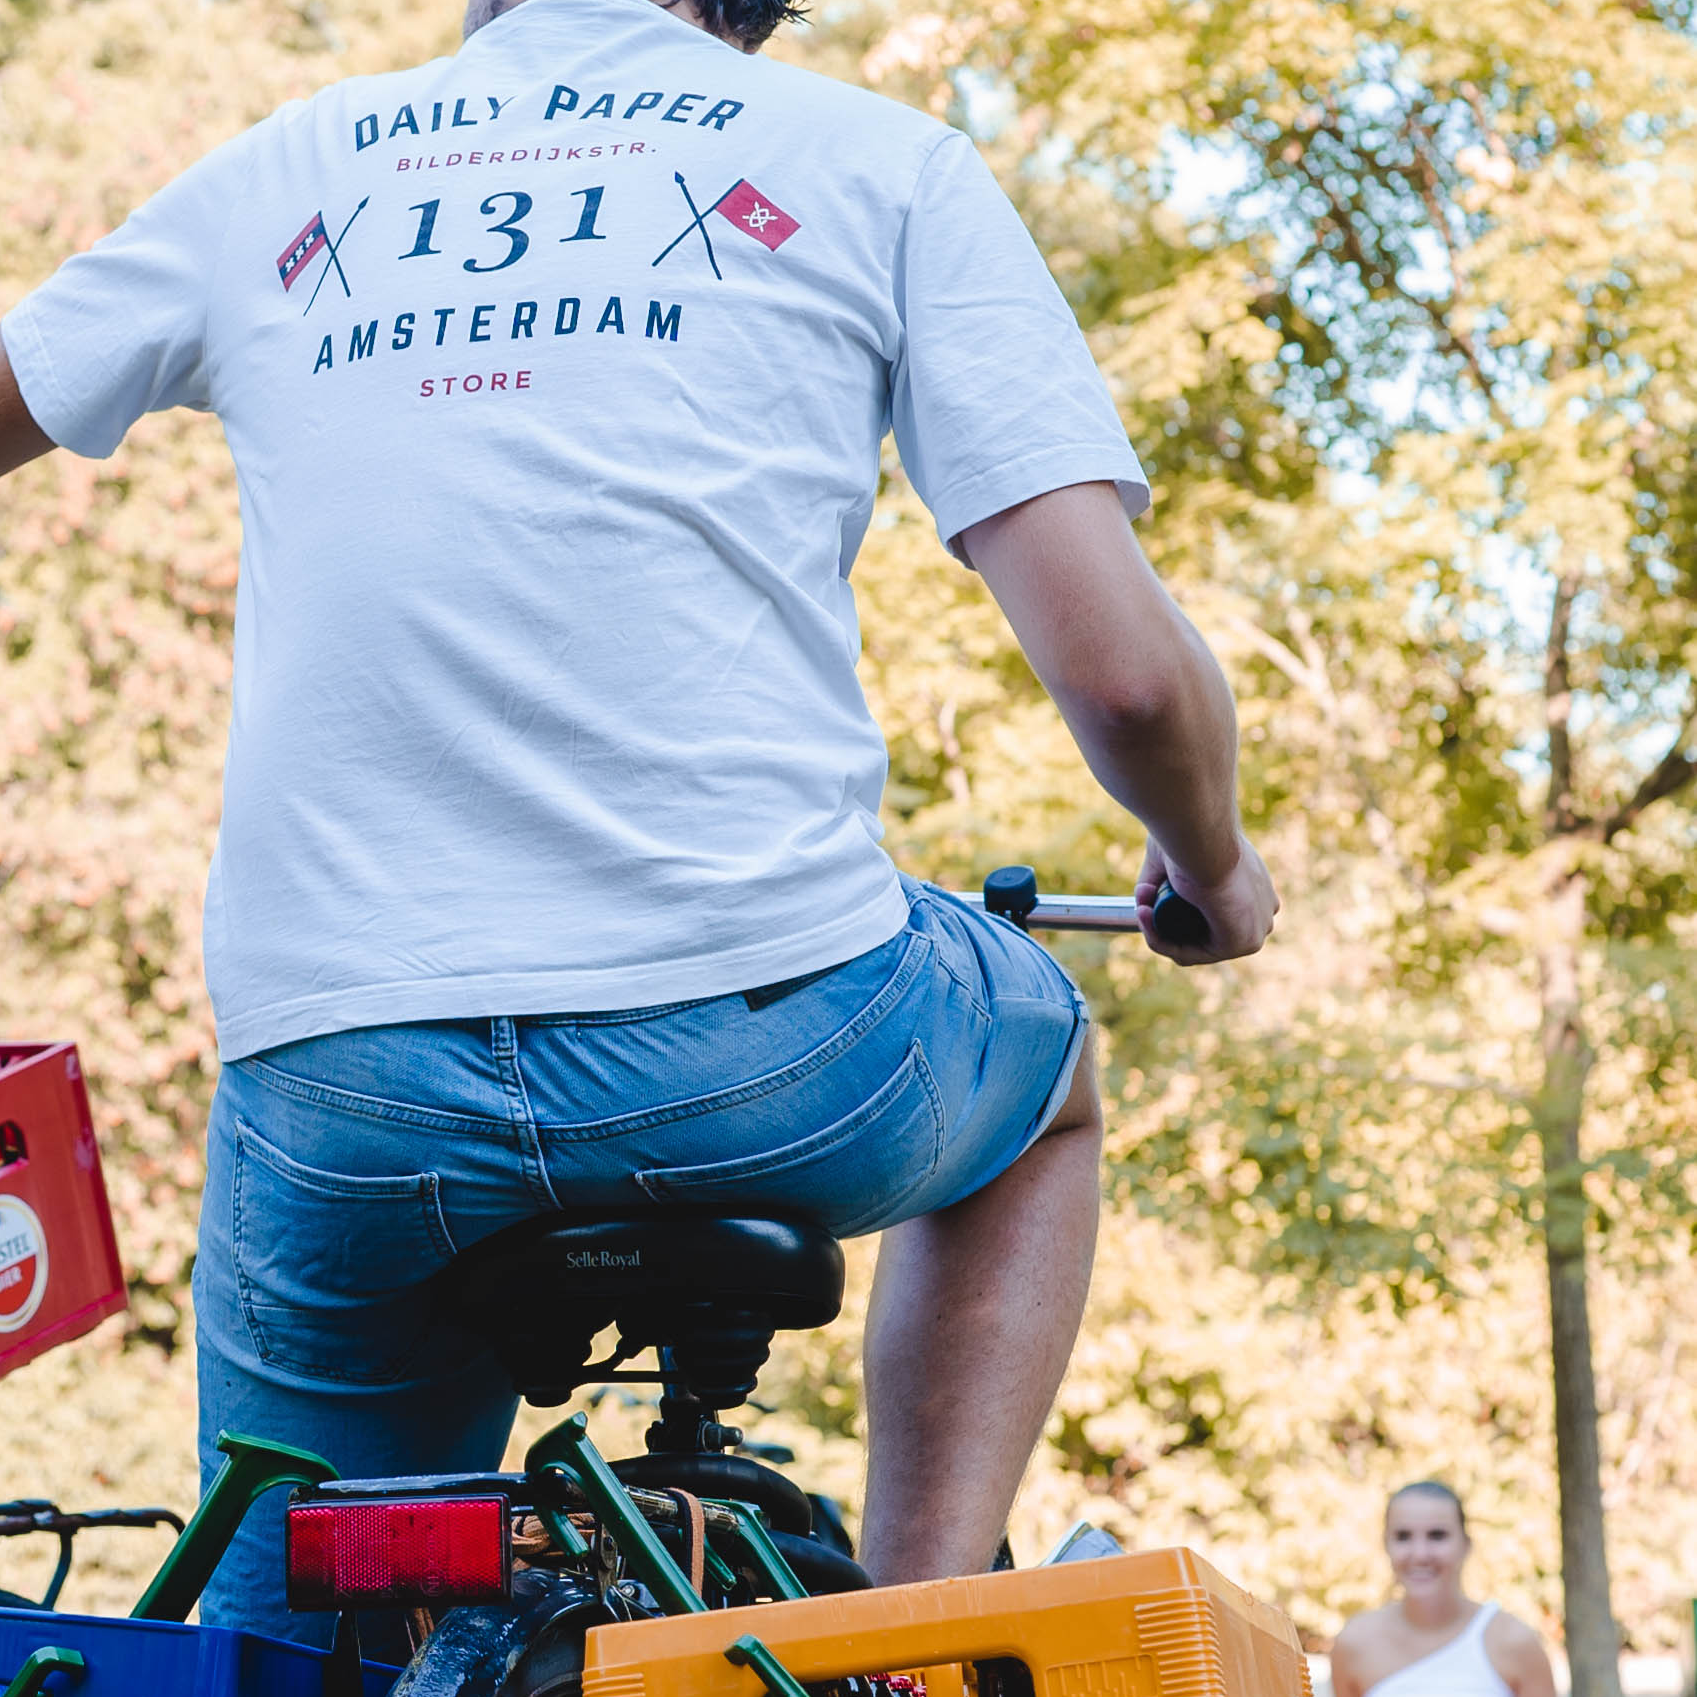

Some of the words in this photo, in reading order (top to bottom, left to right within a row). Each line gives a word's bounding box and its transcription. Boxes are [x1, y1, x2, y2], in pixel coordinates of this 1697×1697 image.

[355, 95, 516, 152] DAILY
[544, 85, 745, 132] PAPER
[396, 141, 657, 171] BILDERDIJKSTR.
[398, 185, 606, 273] 131
[313, 296, 682, 374] AMSTERDAM
[419, 370, 533, 398] STORE
[566, 1251, 598, 1269] Selle
[598, 1249, 643, 1271] Royal
